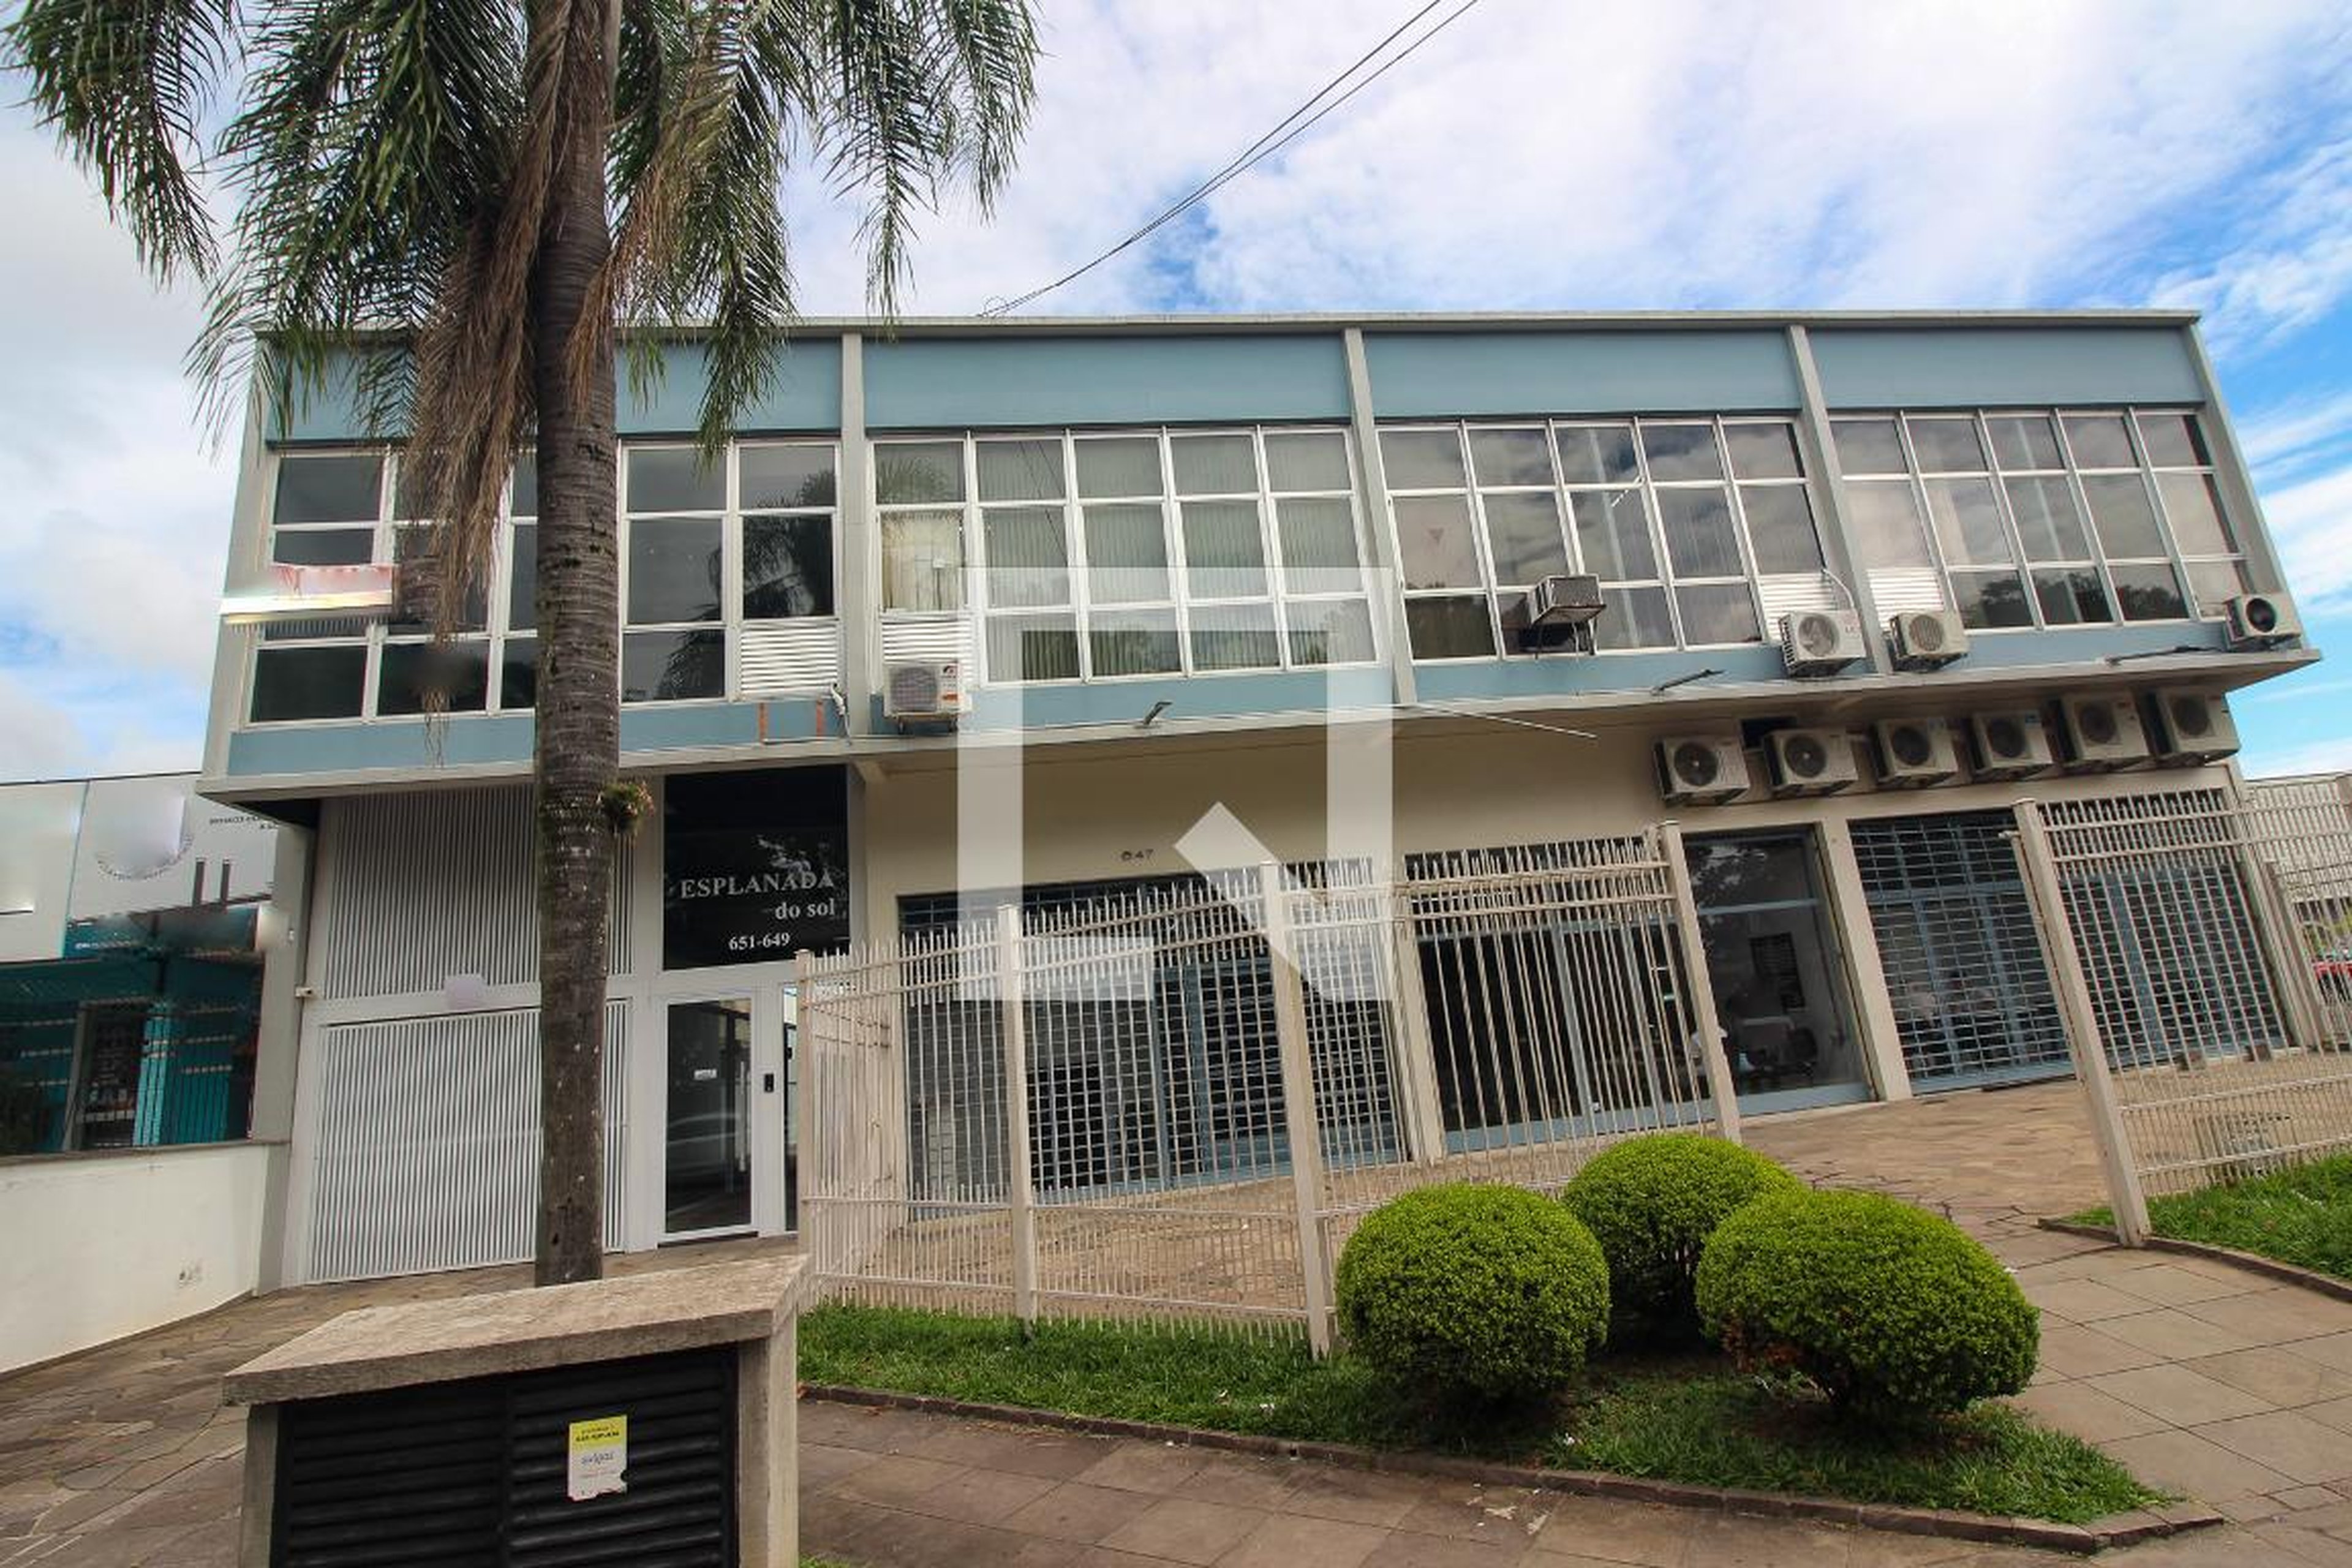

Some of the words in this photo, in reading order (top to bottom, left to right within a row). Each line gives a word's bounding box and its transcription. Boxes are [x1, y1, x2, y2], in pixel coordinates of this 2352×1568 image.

[680, 869, 834, 899] ESPLANADA
[775, 902, 801, 919] do
[807, 899, 835, 918] sol
[728, 932, 790, 950] 651-649
